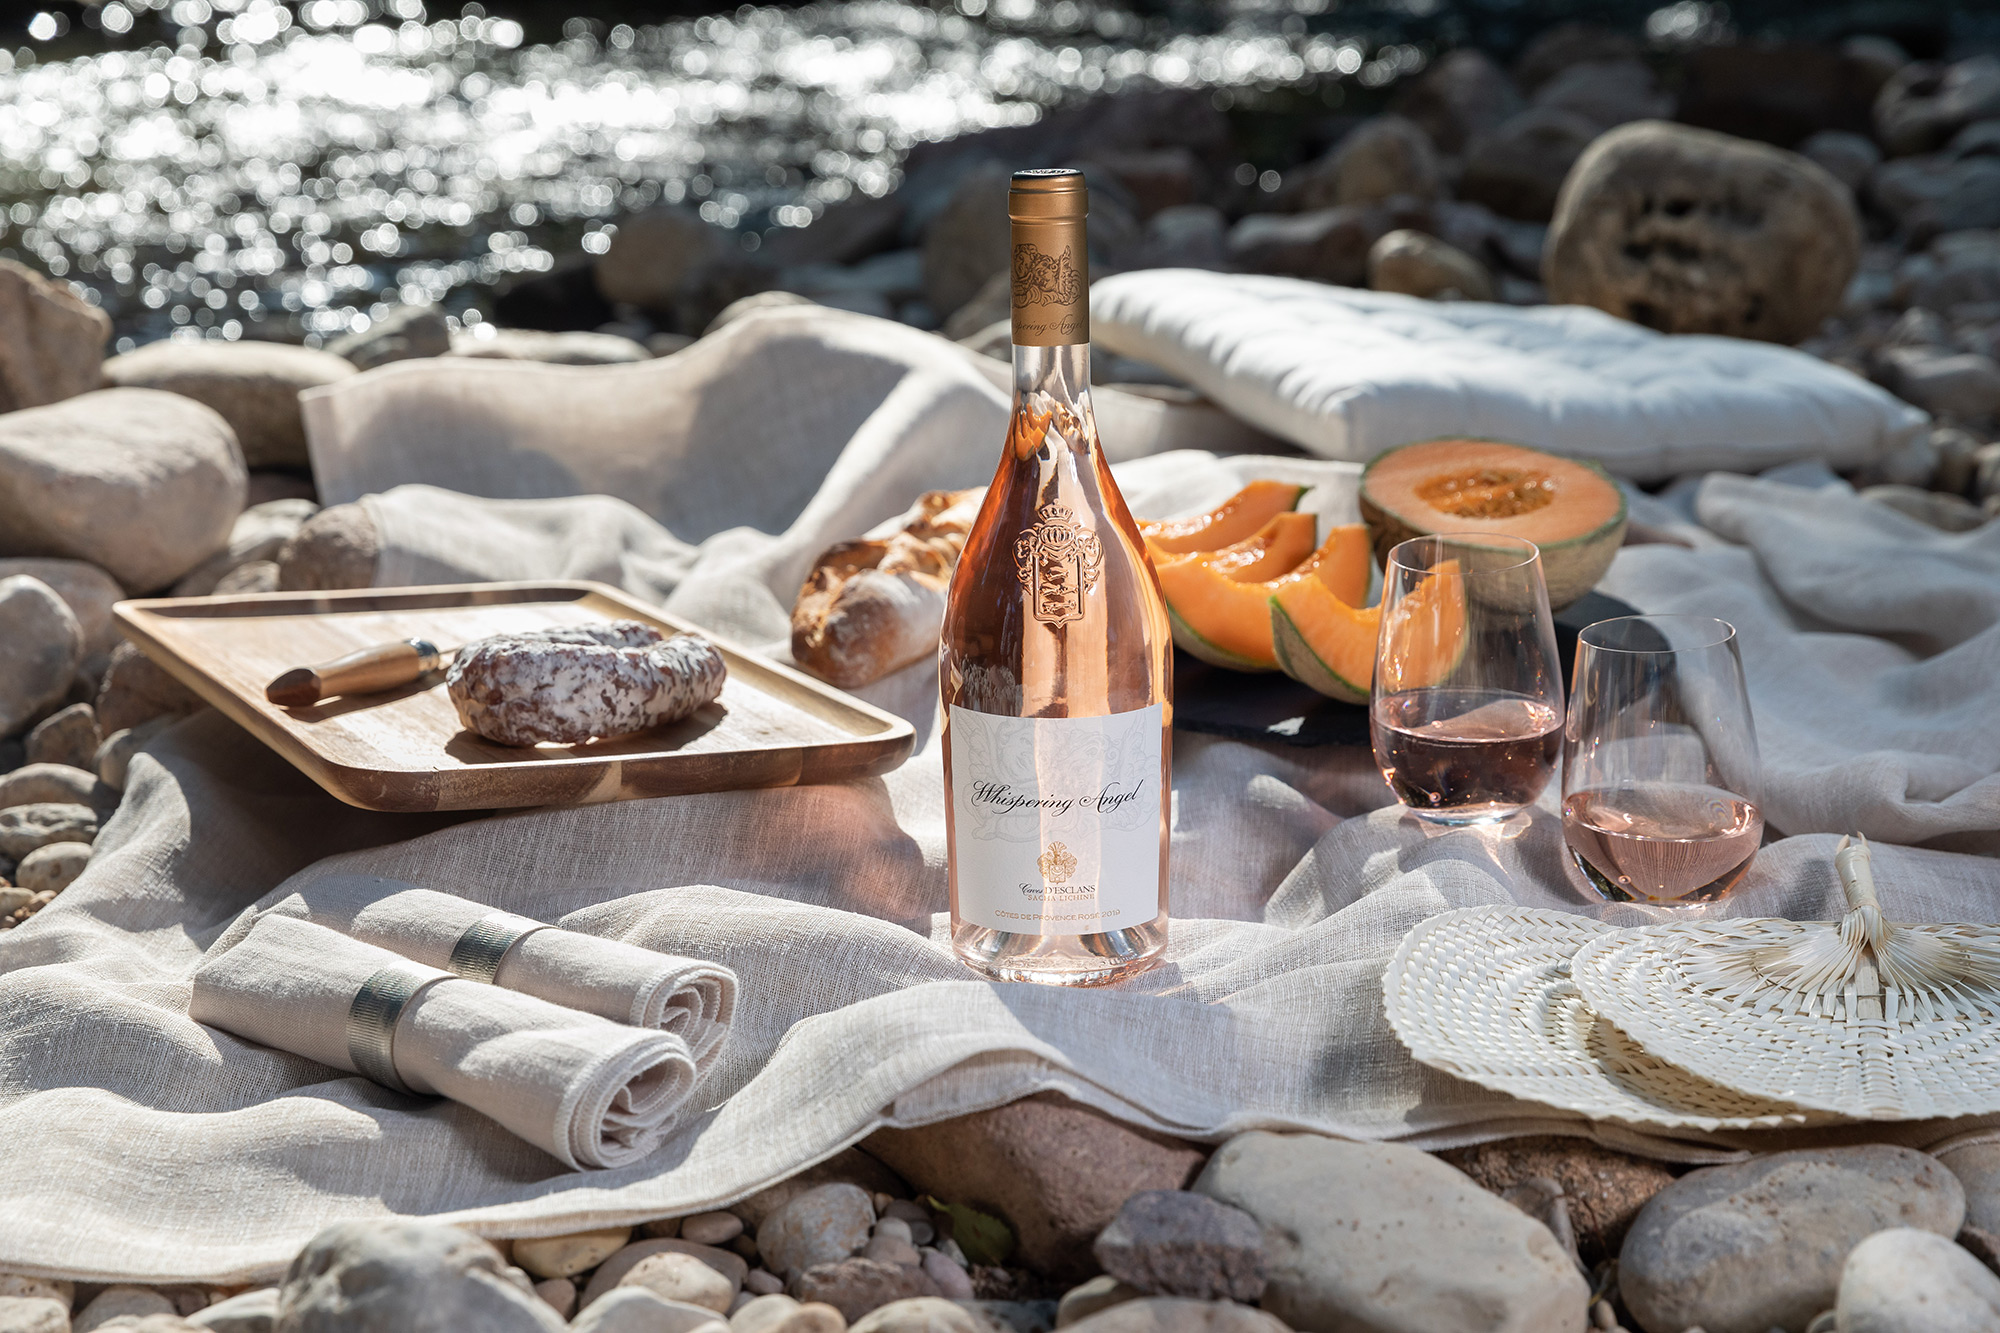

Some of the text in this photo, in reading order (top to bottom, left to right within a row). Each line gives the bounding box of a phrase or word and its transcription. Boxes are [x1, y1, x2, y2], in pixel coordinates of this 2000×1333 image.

[971, 779, 1143, 817] Whispering Angel
[1019, 882, 1096, 896] Caves D'ESCLANS
[1027, 894, 1095, 902] SACHA LICHINE
[994, 909, 1020, 920] CÔTES
[1020, 913, 1032, 921] DE
[1032, 913, 1077, 922] PROVENCE
